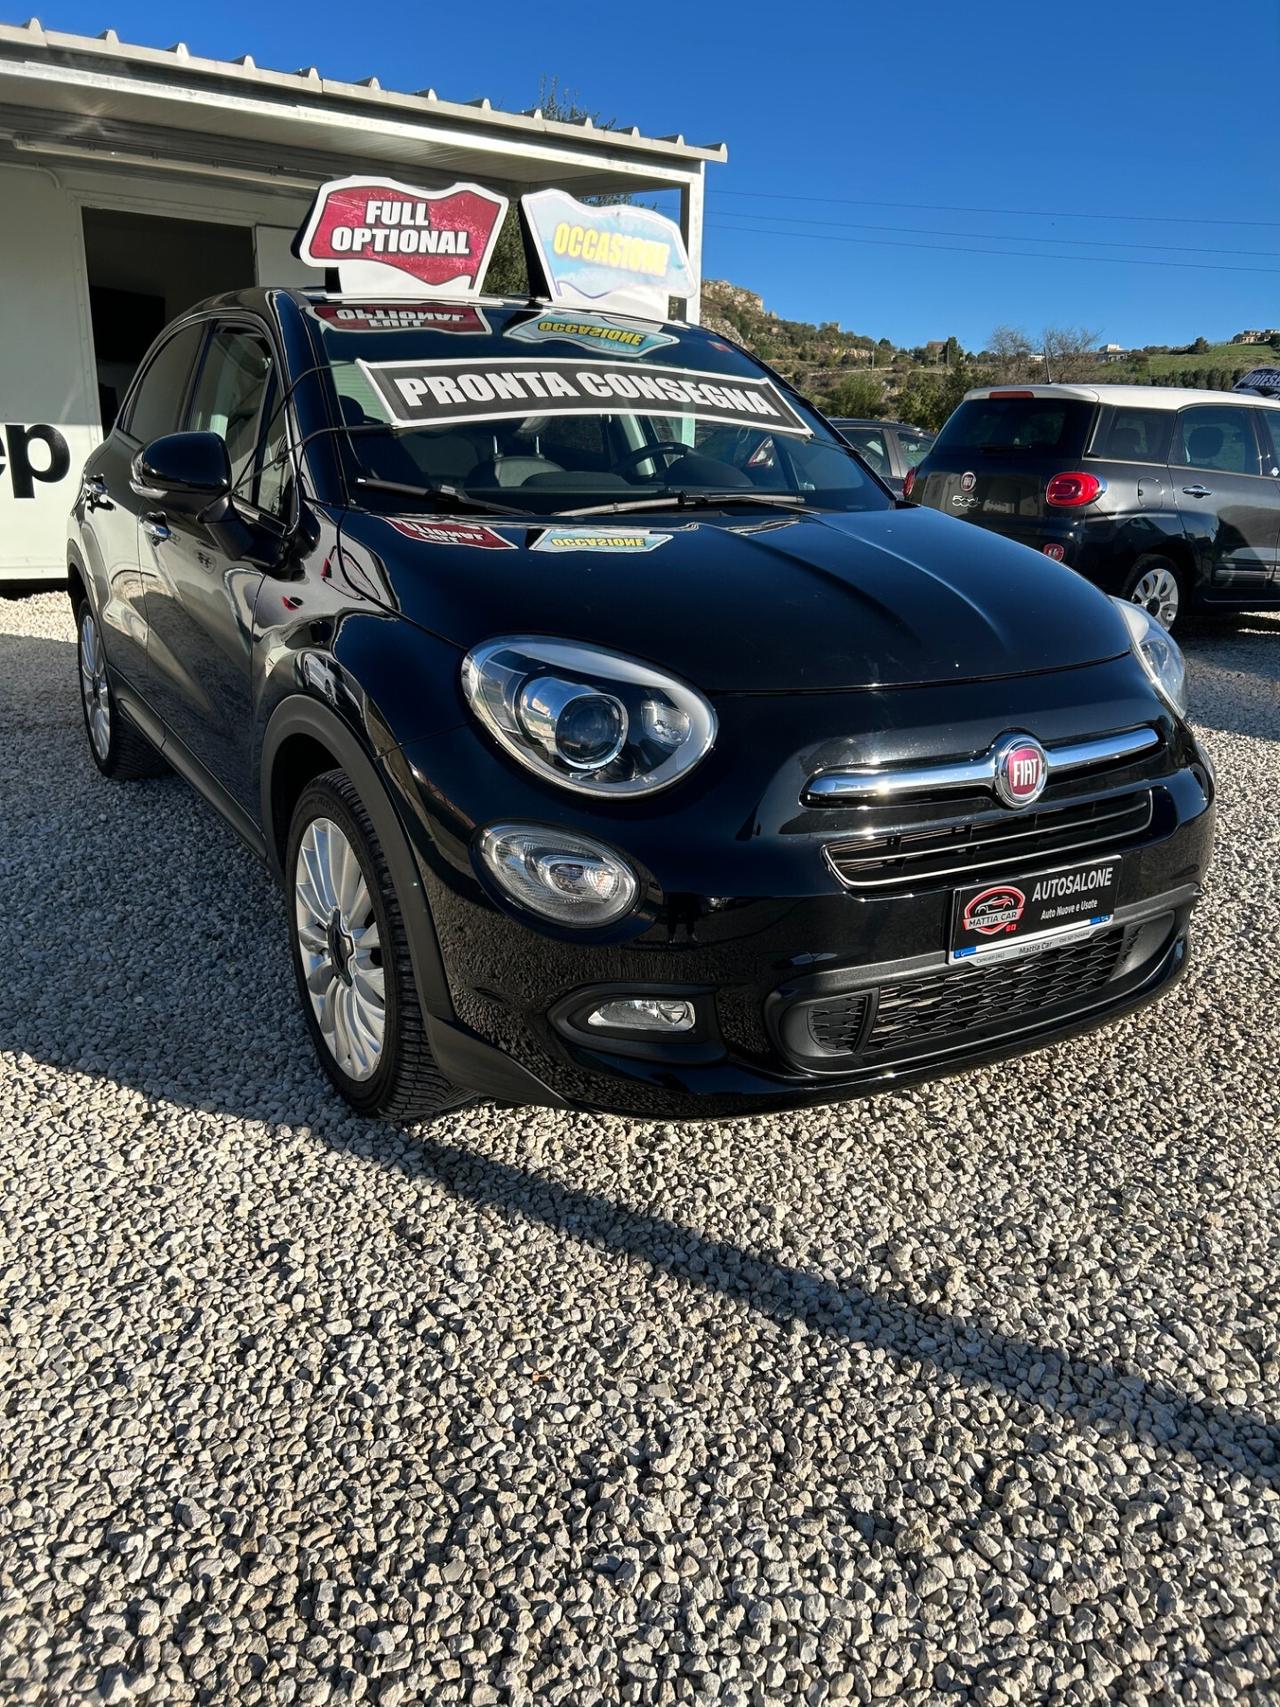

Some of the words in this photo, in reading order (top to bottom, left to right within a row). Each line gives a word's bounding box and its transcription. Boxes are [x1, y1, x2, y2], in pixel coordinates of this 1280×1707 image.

[365, 200, 429, 227] FULL
[331, 226, 470, 255] OPTIONAL
[553, 222, 670, 277] OCCASIONE
[394, 371, 580, 407] PRONTA
[575, 372, 781, 417] CONSEGNA
[0, 423, 71, 499] p
[1013, 758, 1038, 787] FIAT
[1032, 867, 1113, 902] AUTOSALONE
[968, 915, 999, 927] MATTIA
[1000, 911, 1018, 921] CAR
[1040, 909, 1056, 920] Auto
[1075, 903, 1080, 912] e
[1080, 899, 1098, 911] Usate
